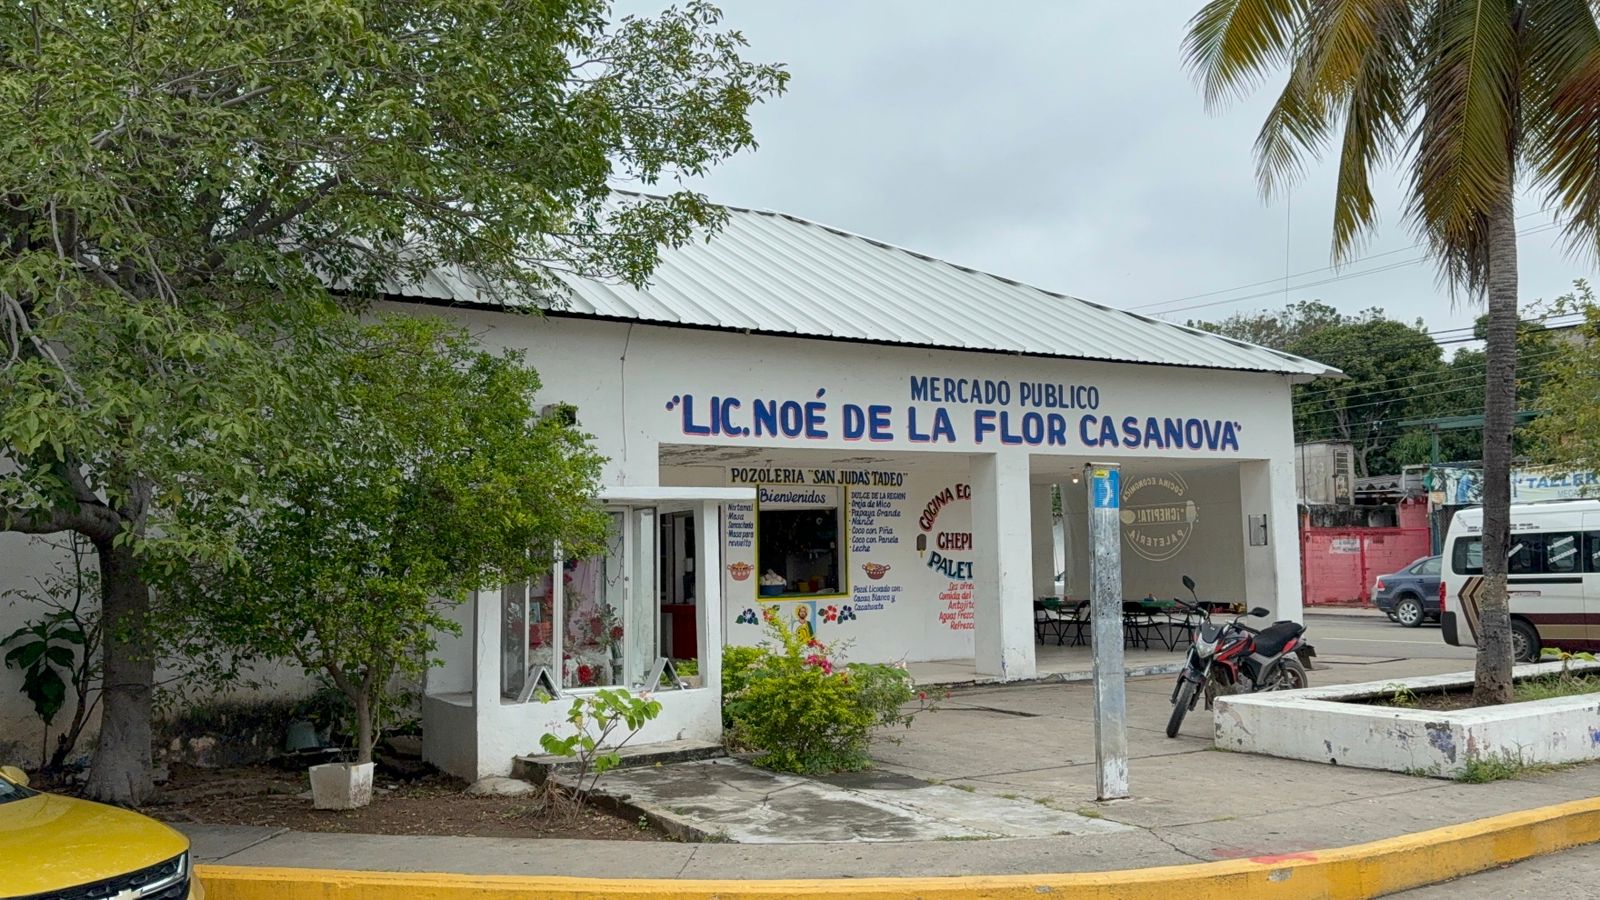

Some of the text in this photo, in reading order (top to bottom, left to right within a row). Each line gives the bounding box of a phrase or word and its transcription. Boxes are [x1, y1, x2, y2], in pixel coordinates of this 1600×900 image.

[910, 375, 1100, 410] MERCADO PUBLICO
[753, 387, 828, 440] NOÉ
[842, 403, 894, 442] DE
[907, 406, 956, 443] LA
[974, 409, 1067, 447] FLOR
[731, 468, 805, 483] POZOLERIA
[837, 470, 870, 485] JUDAS
[759, 488, 826, 504] Bienvenidos
[871, 491, 879, 500] DE
[879, 492, 887, 500] LA
[867, 500, 876, 508] de
[876, 500, 891, 508] Mico
[851, 509, 901, 519] Papaya Grande
[919, 487, 955, 532] COCINA
[728, 512, 744, 520] Masa
[852, 526, 865, 535] Coco
[852, 535, 866, 544] Coco
[852, 544, 871, 552] Leche
